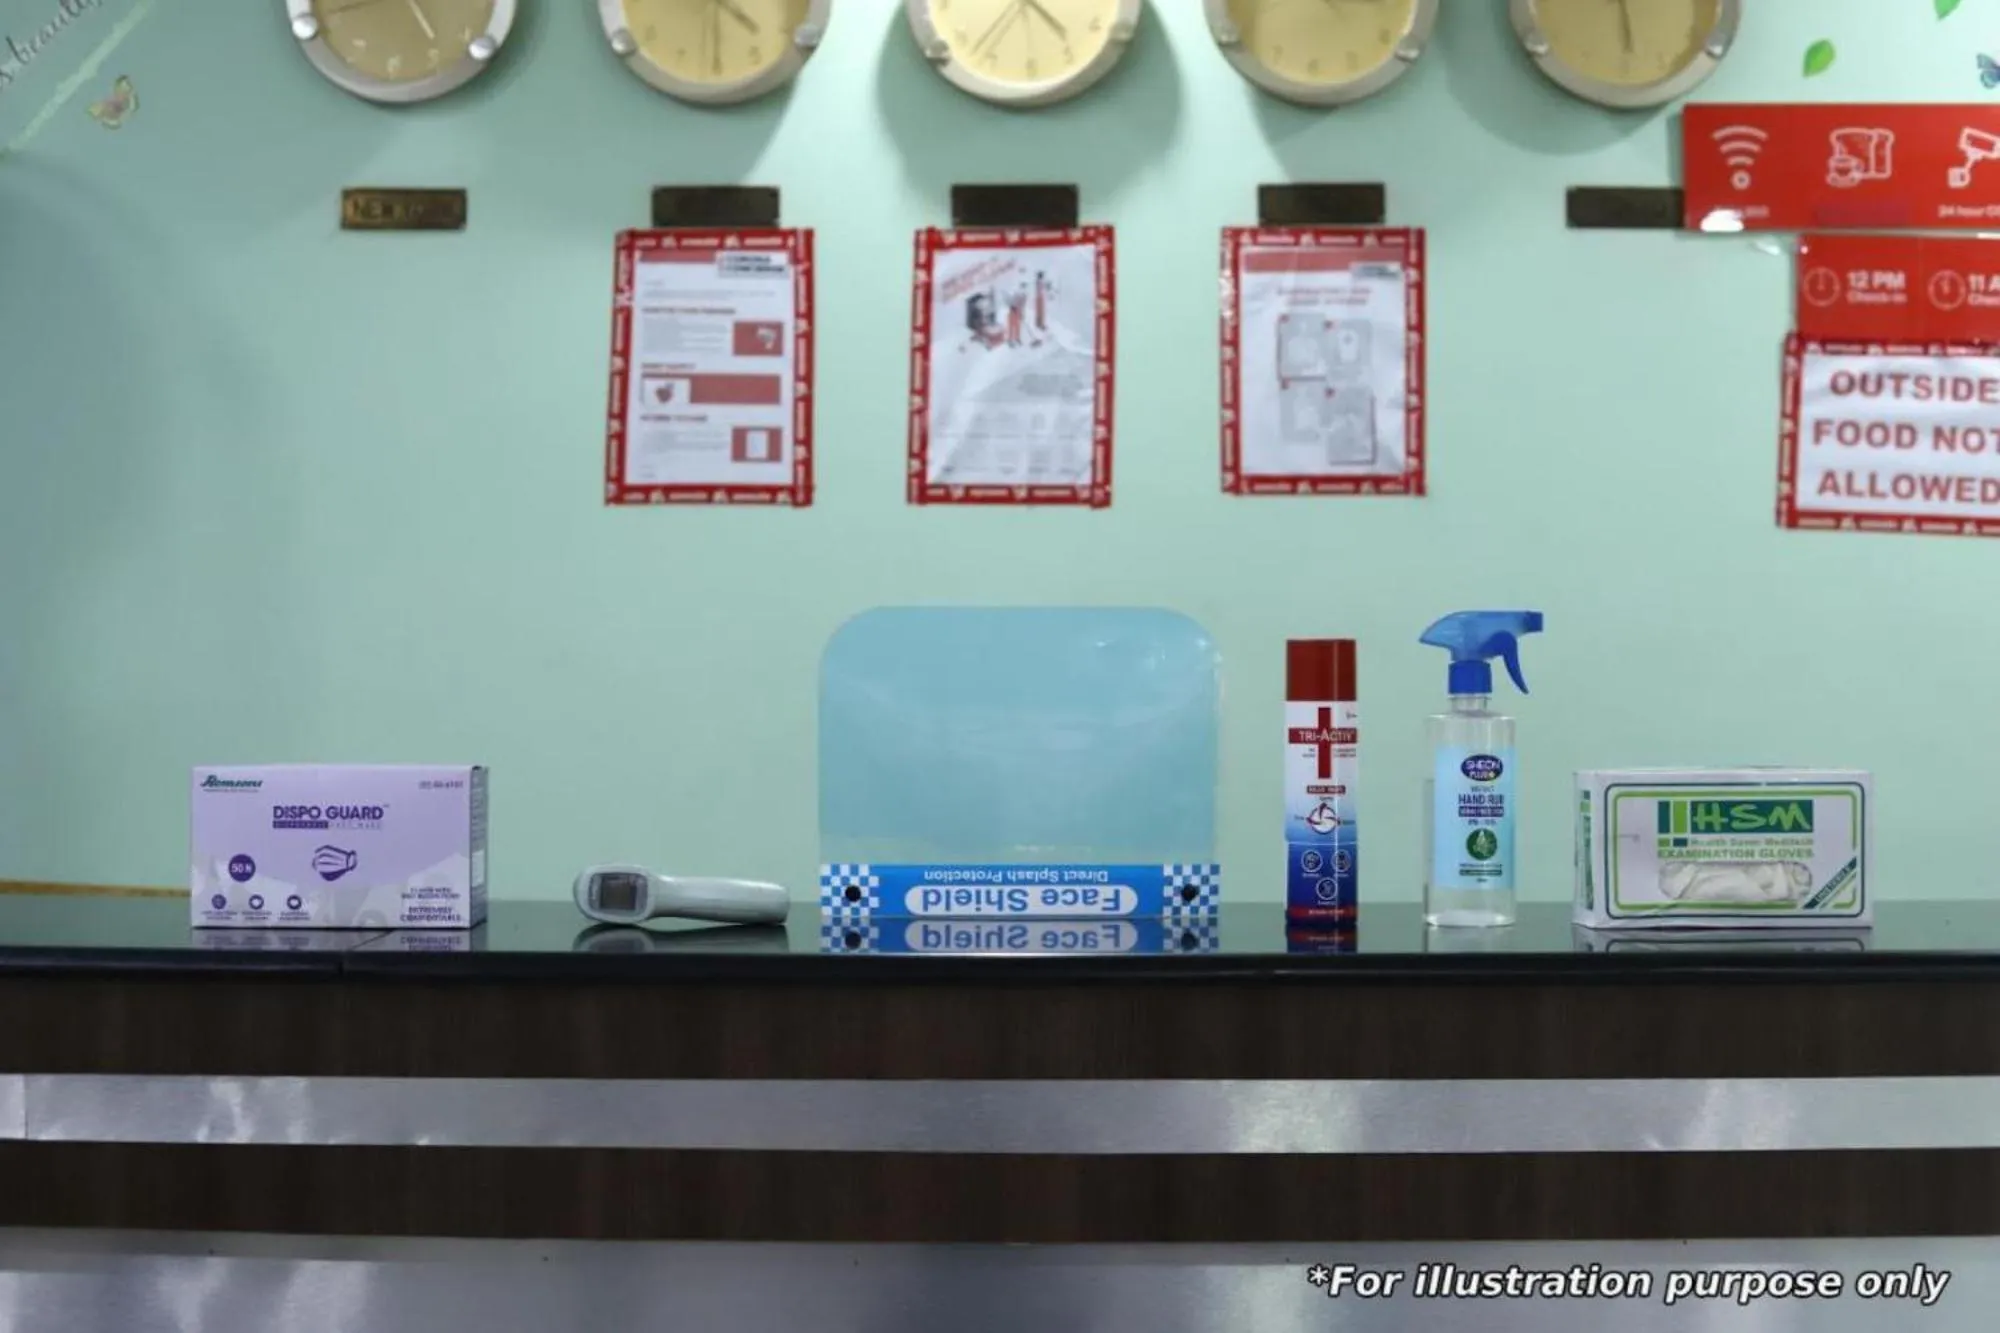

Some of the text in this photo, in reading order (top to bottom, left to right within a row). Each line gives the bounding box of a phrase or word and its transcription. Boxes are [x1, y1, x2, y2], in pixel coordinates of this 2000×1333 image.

[1847, 271, 1906, 289] 12 PM
[1968, 274, 1985, 291] 11
[1829, 370, 2000, 403] OUTSIDE
[1812, 418, 1917, 449] FOOD
[1816, 470, 2000, 504] ALLOWED
[1458, 794, 1485, 805] HAND
[273, 805, 384, 820] DISPO GUARD
[1693, 802, 1811, 832] HSM
[1657, 848, 1813, 859] EXAMINATION GLOVES
[231, 863, 244, 873] 50
[924, 869, 1108, 882] Direct Splash Protection
[922, 888, 1121, 912] Face Shield
